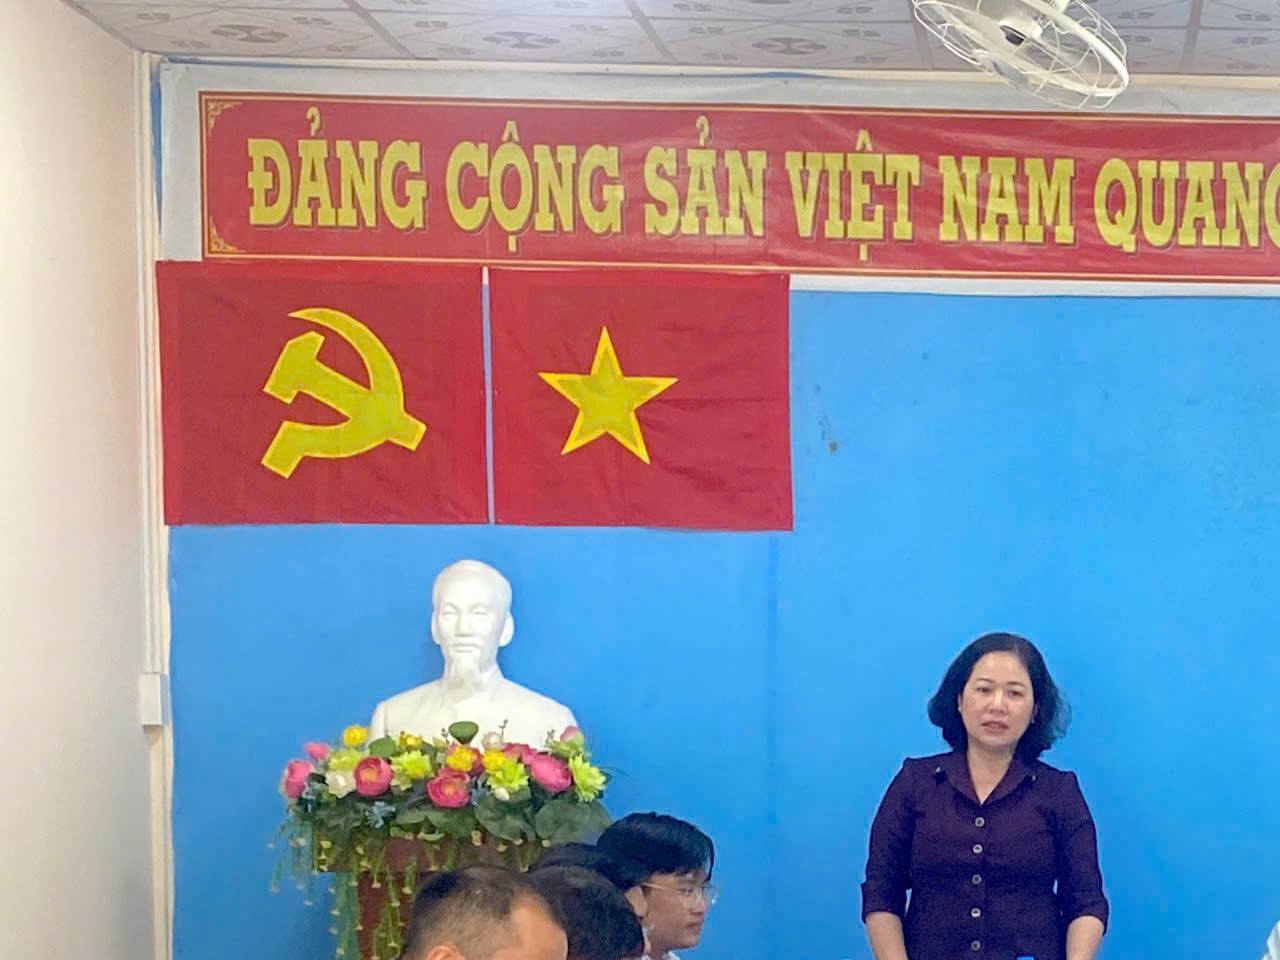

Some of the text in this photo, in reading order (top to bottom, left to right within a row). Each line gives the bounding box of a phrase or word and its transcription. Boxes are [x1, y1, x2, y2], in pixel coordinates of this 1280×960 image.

[247, 106, 428, 229] ĐẢNG
[446, 120, 625, 252] CỘNG
[643, 116, 767, 237] SẢN
[785, 129, 921, 260] VIỆT
[938, 154, 1075, 244] NAM
